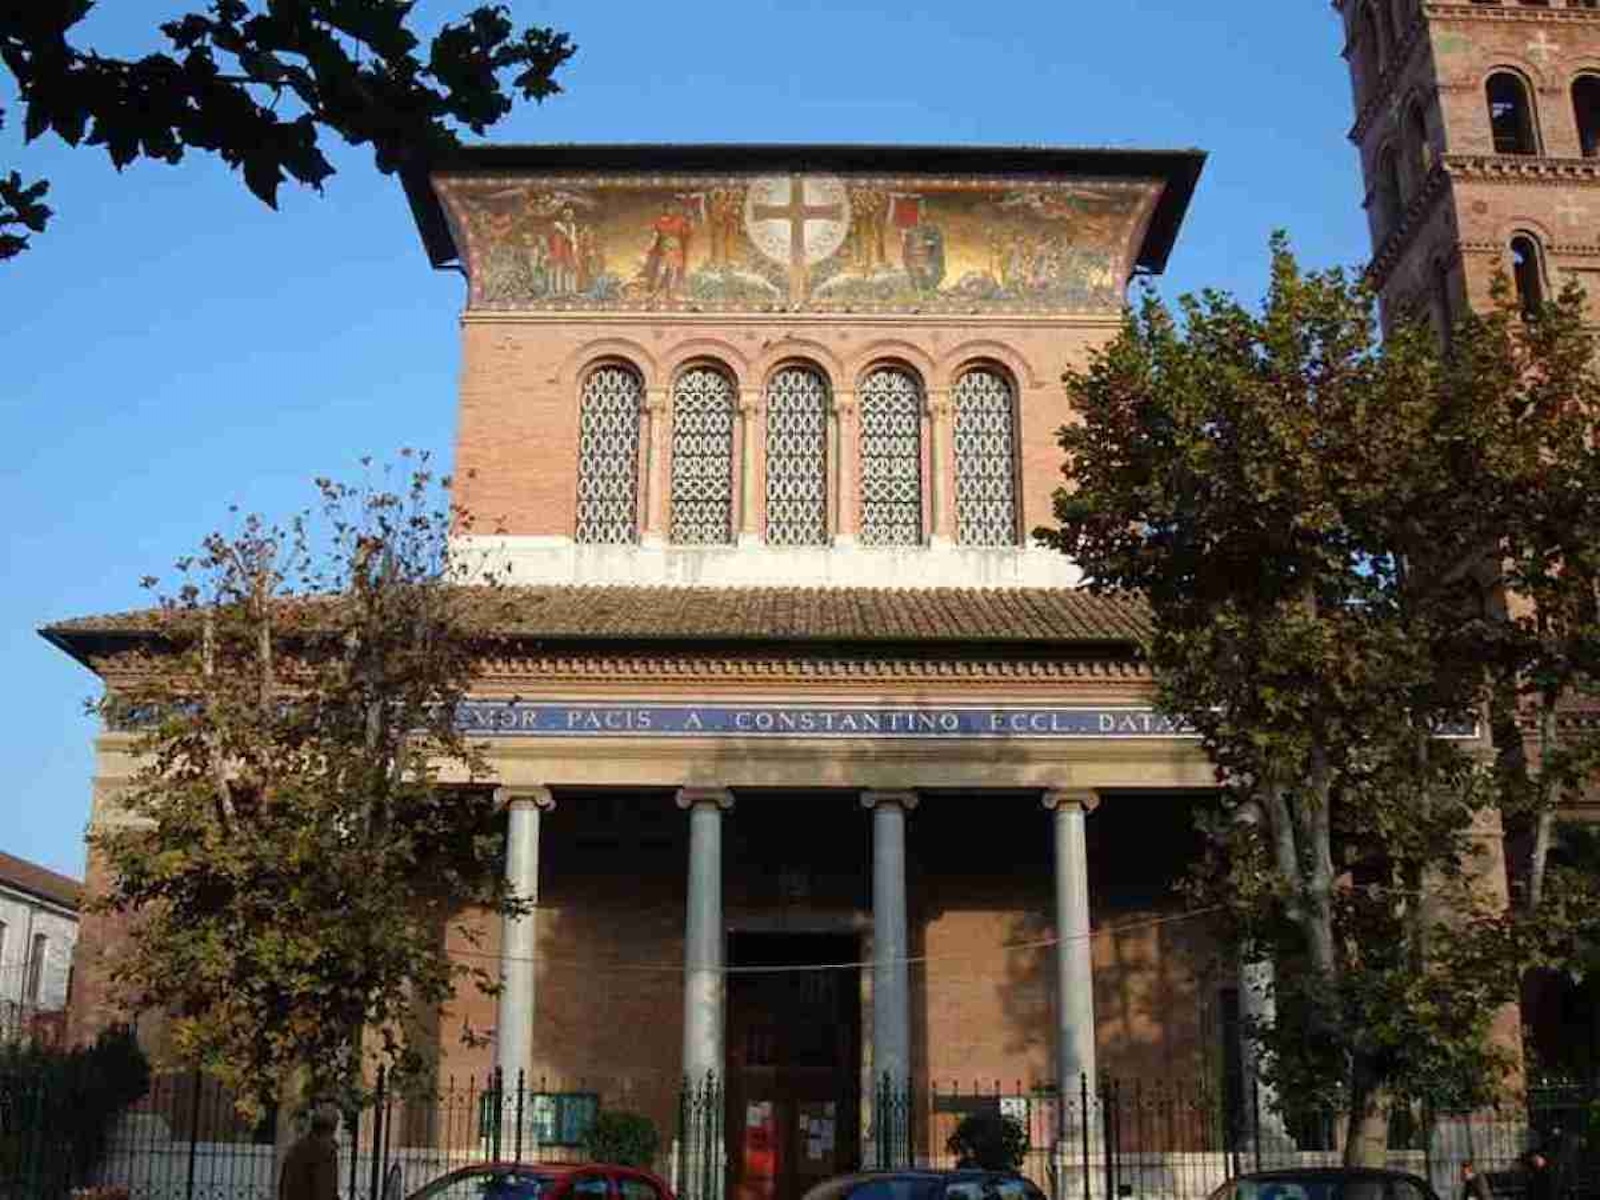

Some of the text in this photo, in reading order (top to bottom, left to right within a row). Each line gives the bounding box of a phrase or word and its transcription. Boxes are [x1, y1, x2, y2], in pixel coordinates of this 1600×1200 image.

[567, 709, 652, 728] PACIS
[682, 711, 704, 730] A
[735, 710, 960, 731] CONSTANTINO
